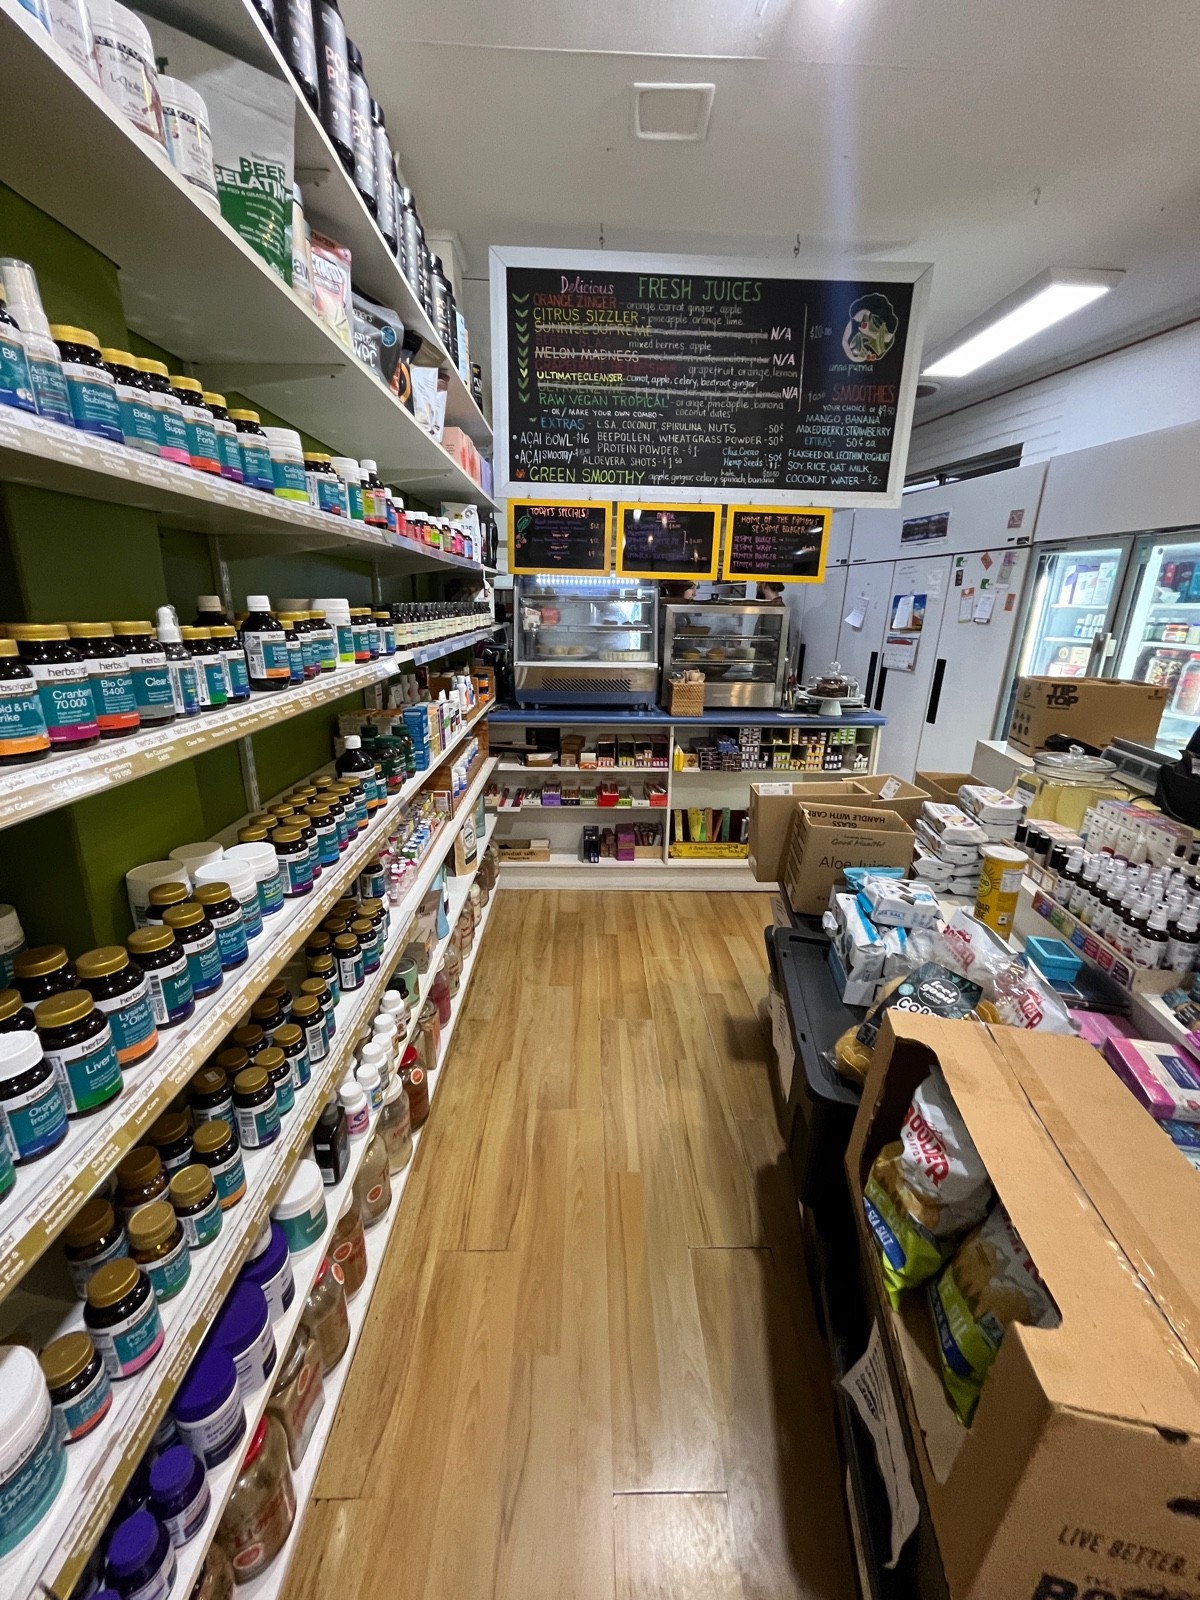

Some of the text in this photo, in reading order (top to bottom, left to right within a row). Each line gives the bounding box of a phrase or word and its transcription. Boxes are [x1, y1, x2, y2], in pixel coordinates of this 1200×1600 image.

[560, 275, 763, 302] Delicious FRESH JUICES
[533, 293, 573, 307] ORANGE
[576, 294, 617, 309] ZINGER
[533, 307, 580, 322] CITRUS
[586, 309, 638, 324] SIZZLER
[770, 326, 792, 341] N/A
[628, 339, 654, 349] mixed
[656, 340, 684, 350] berries
[689, 341, 712, 354] apple
[772, 353, 795, 366] N/A
[772, 366, 798, 379] lemon
[781, 386, 799, 400] N/A
[831, 384, 896, 404] SMOOTHIES
[539, 393, 566, 405] RAW
[571, 395, 610, 406] VEGAN
[614, 395, 669, 408] TROPICAL
[568, 408, 589, 416] MAKE
[592, 409, 612, 417] YOUR
[822, 404, 866, 412] YOUR CHOICE
[541, 416, 585, 430] EXTRAS
[708, 423, 737, 433] NUTS
[845, 415, 881, 425] BANANA
[725, 435, 762, 444] POWDER
[597, 442, 637, 454] PROTEIN
[639, 444, 679, 456] POWDER
[582, 456, 626, 466] ALOEVERA
[630, 457, 657, 467] SHOTS
[723, 458, 742, 469] Hemp
[743, 458, 763, 467] Seeds
[830, 462, 847, 472] OAT
[529, 465, 576, 483] GREEN
[582, 469, 646, 484] SMOOTHY
[785, 474, 860, 485] COCONUT WATER
[741, 516, 761, 524] HOME
[751, 524, 781, 534] SESAME
[101, 679, 115, 688] Bio
[145, 677, 167, 687] Clear
[102, 687, 125, 696] 5400
[1050, 684, 1078, 697] TIP
[1046, 694, 1079, 707] TOP
[829, 812, 886, 824] HANDLE WITH
[832, 820, 858, 829] GLASS
[818, 856, 852, 870] Aloe
[920, 983, 956, 1004] good
[119, 1003, 146, 1021] Lysine
[129, 1011, 149, 1025] Olive
[85, 1056, 110, 1075] Liver
[875, 1225, 894, 1246] SALT
[1057, 1524, 1188, 1577] LIVE BETTER
